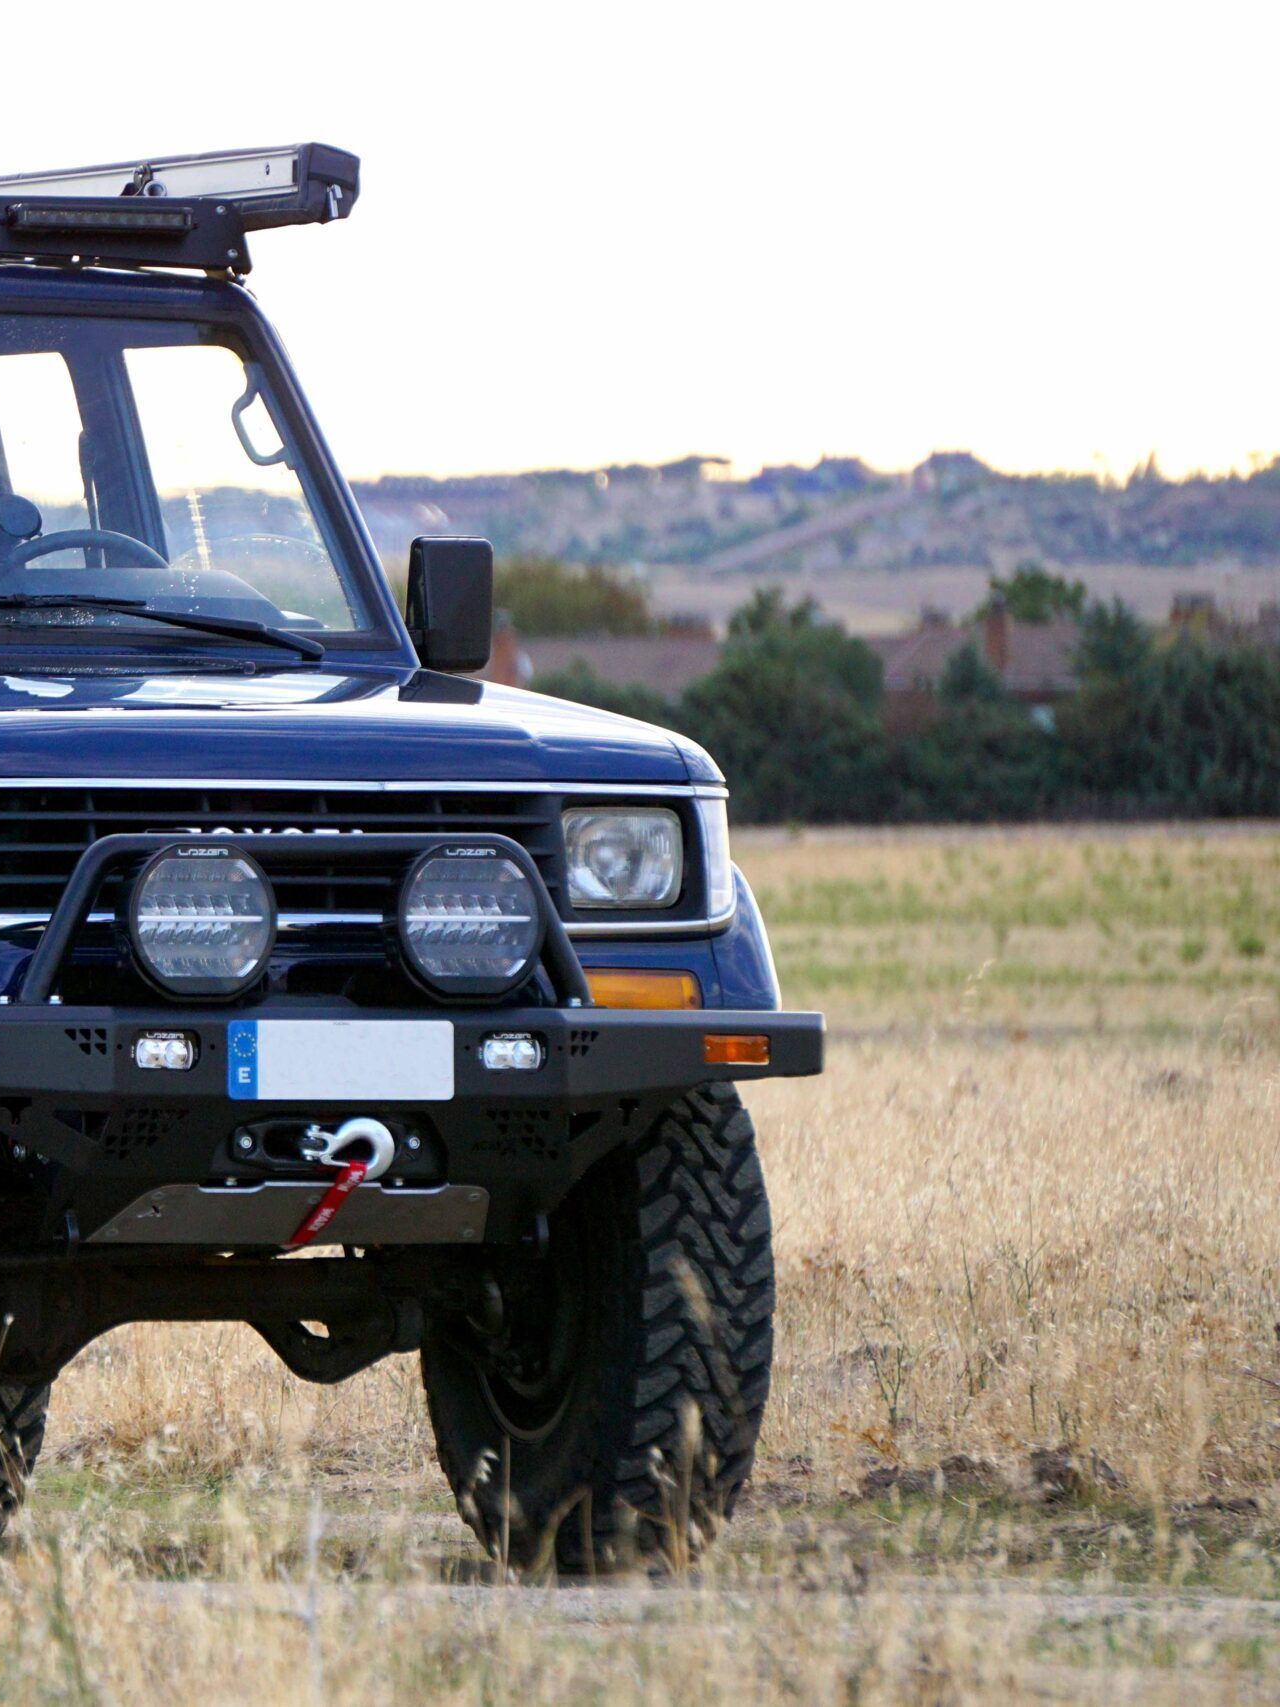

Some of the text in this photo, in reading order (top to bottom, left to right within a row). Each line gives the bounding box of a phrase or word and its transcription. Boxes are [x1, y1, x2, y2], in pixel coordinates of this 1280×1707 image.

[178, 848, 228, 857] LAZER
[446, 848, 497, 857] LAZER
[238, 1067, 251, 1083] E
